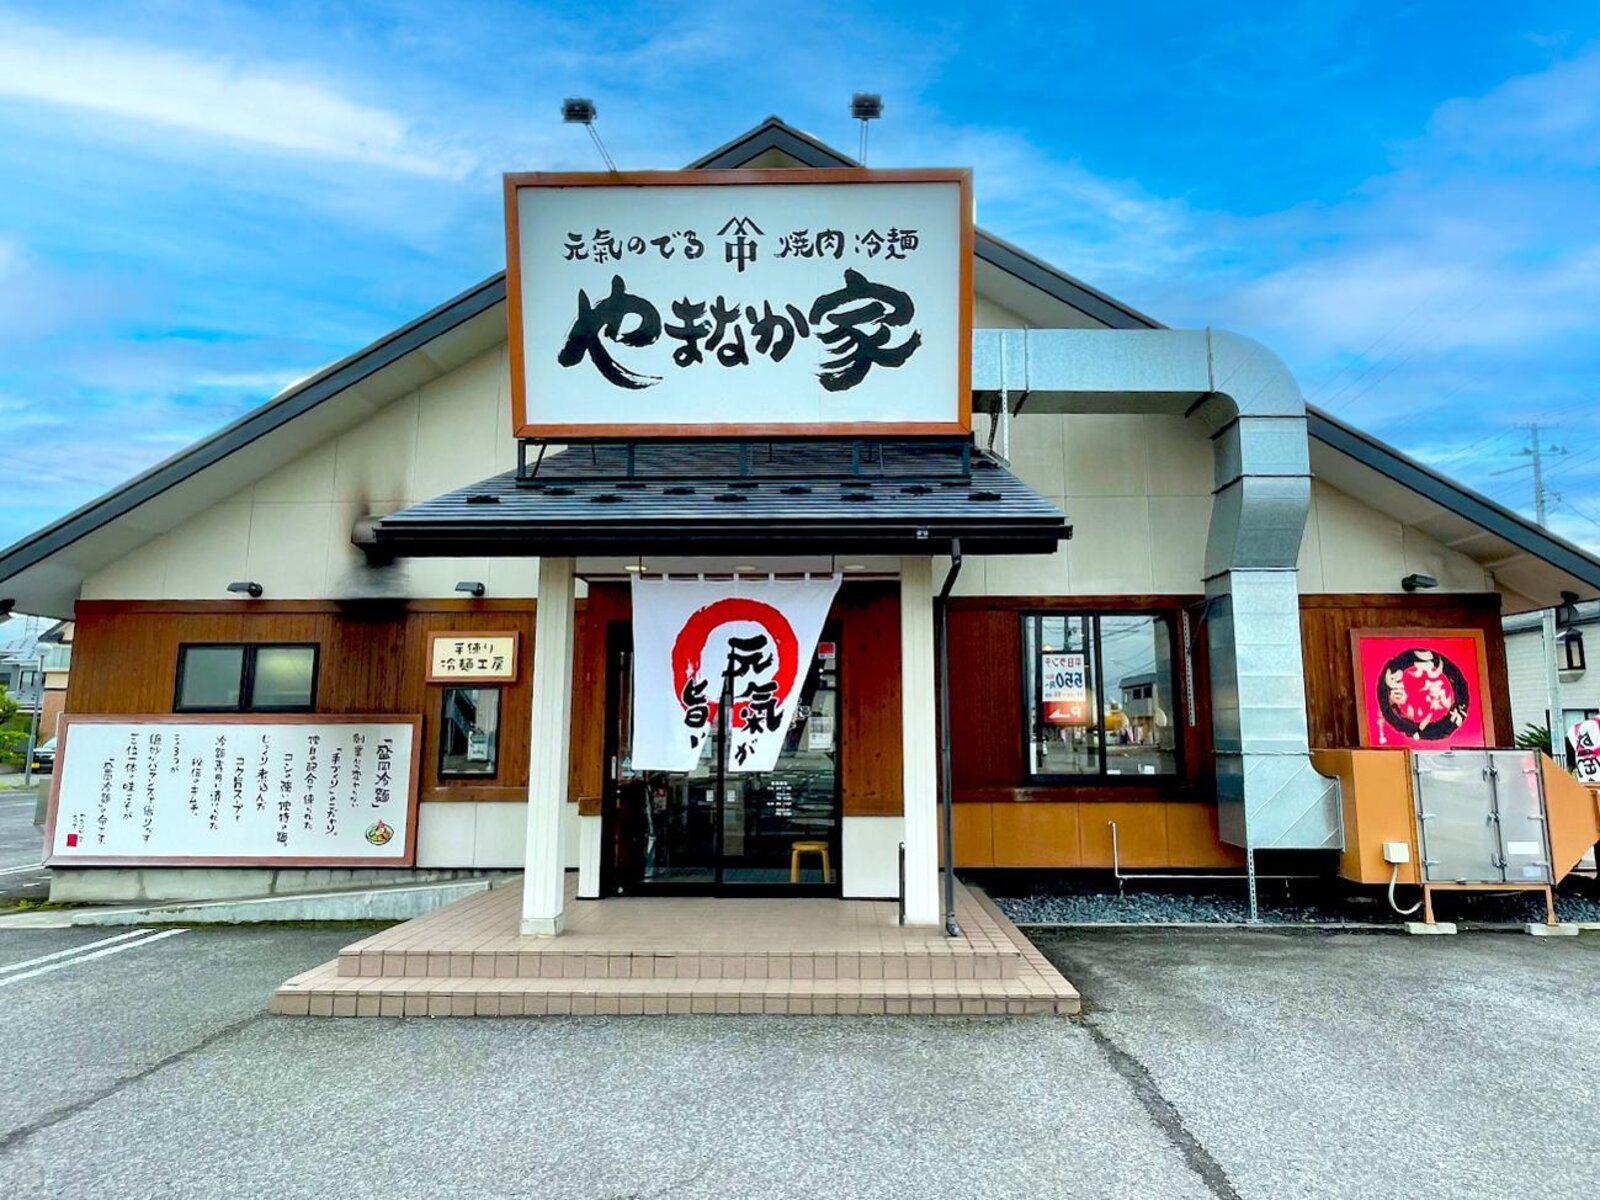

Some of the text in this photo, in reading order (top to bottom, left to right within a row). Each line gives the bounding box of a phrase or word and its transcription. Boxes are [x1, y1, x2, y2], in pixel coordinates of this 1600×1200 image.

[563, 229, 704, 262] 元氣のでる
[557, 268, 922, 393] やまなか家
[441, 656, 505, 671] 冷麺工房
